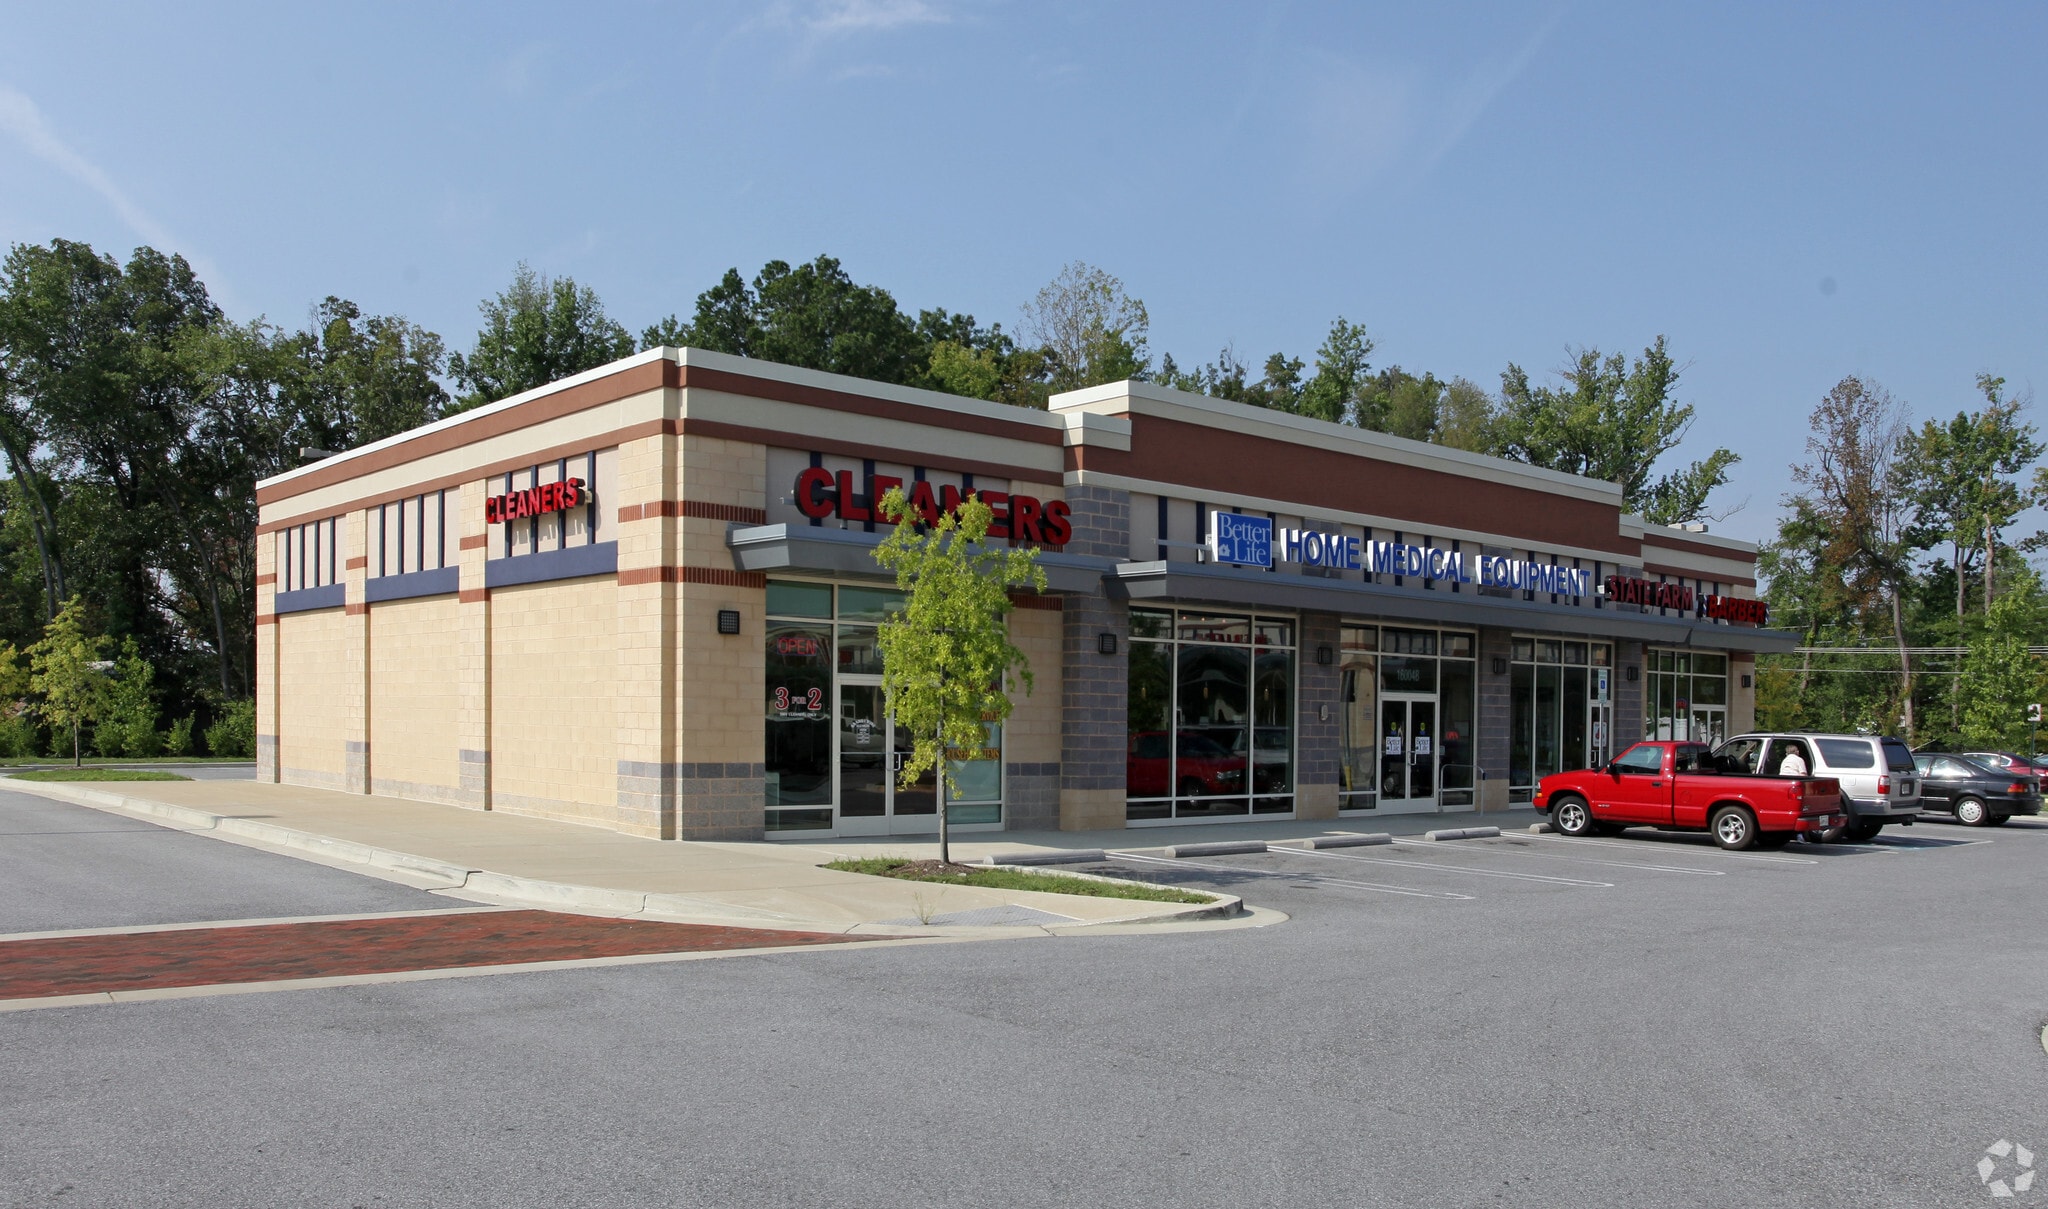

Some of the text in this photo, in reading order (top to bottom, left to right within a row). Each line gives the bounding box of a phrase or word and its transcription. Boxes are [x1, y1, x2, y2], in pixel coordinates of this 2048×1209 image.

[486, 477, 581, 524] CLEANERS
[796, 466, 1072, 546] CLEANERS
[1219, 514, 1270, 544] Better
[1233, 538, 1266, 565] Life
[1283, 528, 1591, 598] HOME MEDICAL EQUIPMENT
[1608, 575, 1693, 611] STATE FARM
[1708, 594, 1767, 624] BARBER
[778, 638, 816, 656] OPEN
[775, 687, 822, 710] 3 FOR 2
